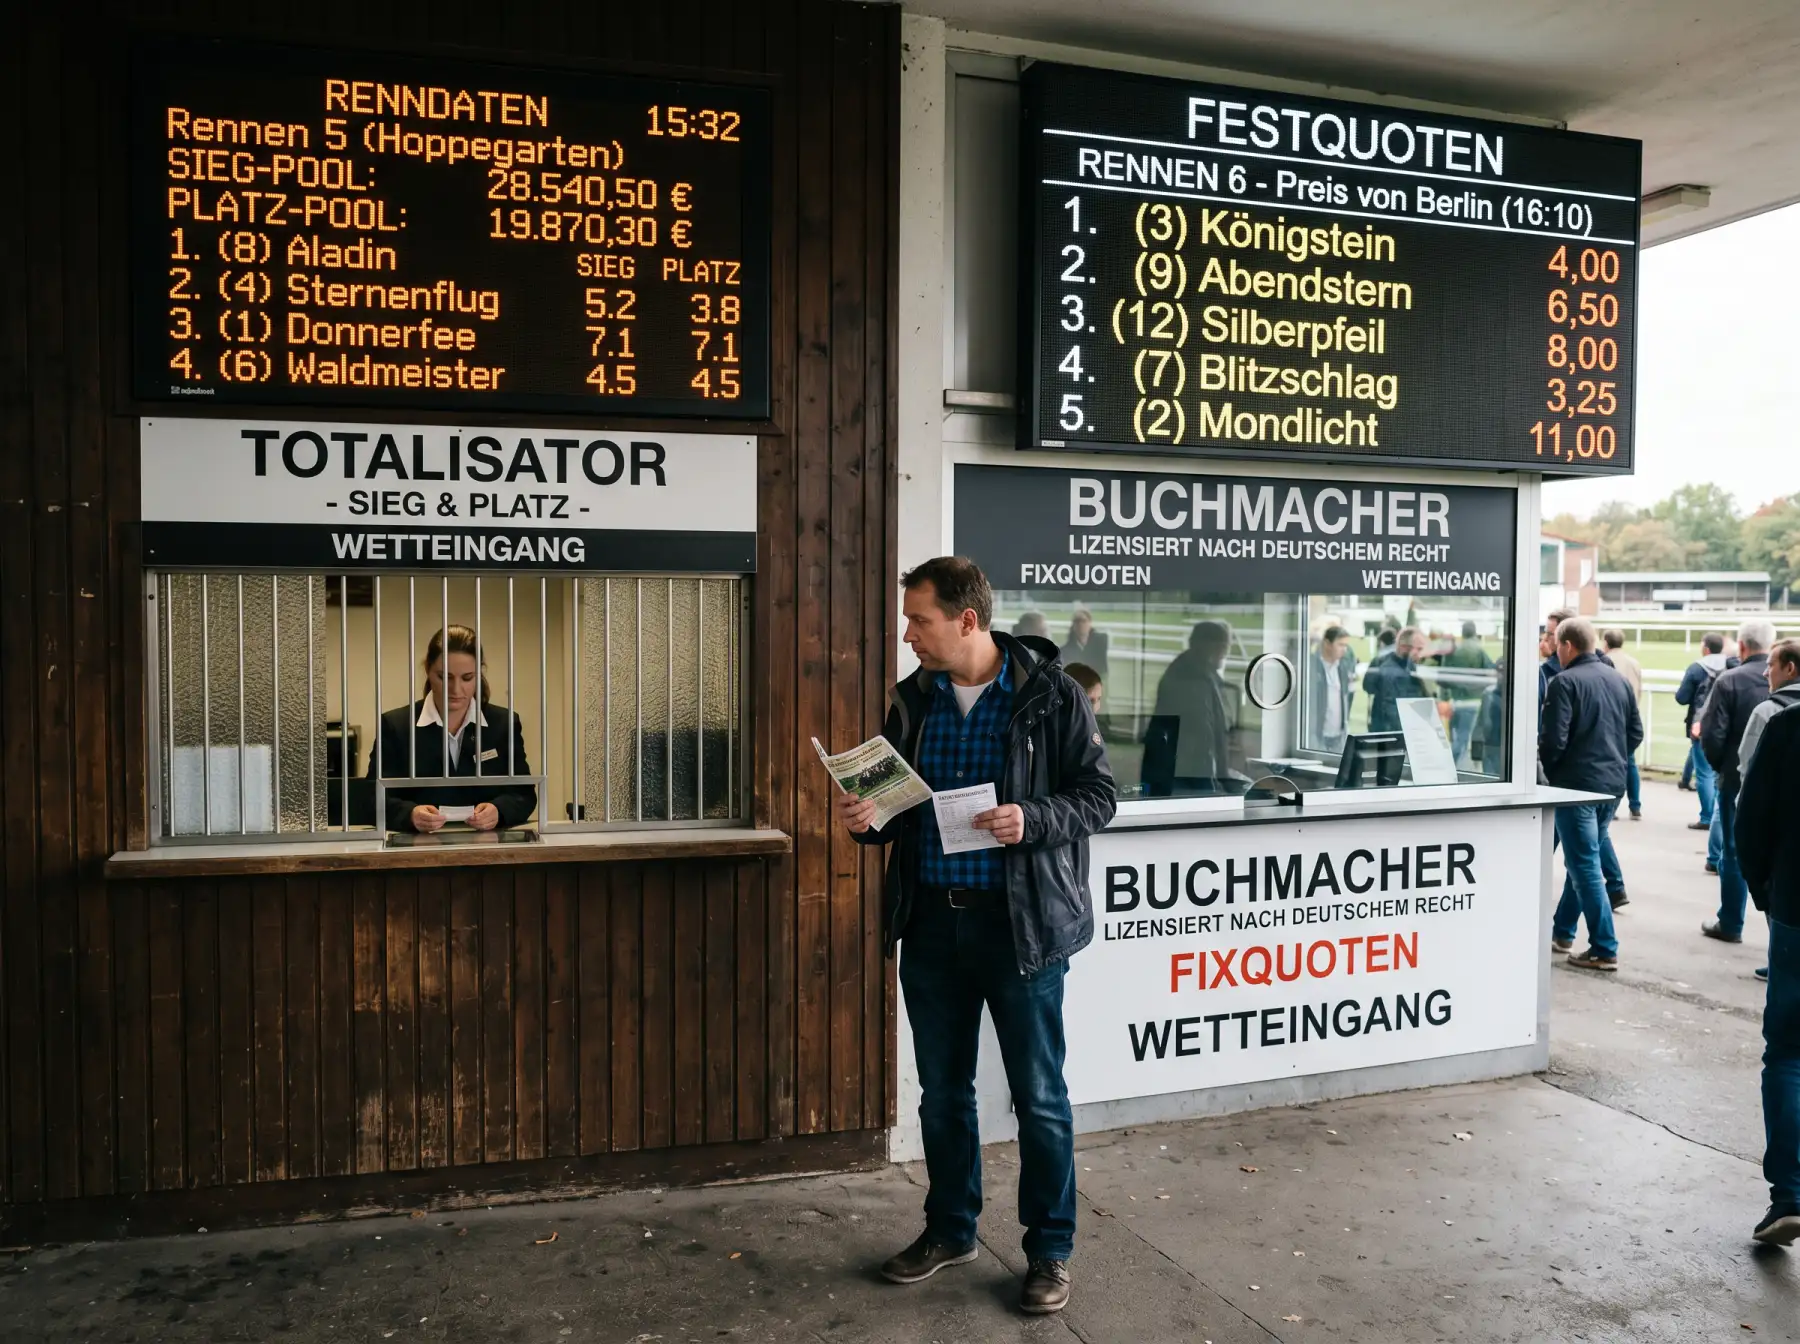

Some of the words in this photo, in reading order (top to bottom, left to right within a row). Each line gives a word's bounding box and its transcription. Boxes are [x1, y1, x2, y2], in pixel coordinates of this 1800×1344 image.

[168, 108, 308, 148] Rennen
[326, 118, 347, 150] 5
[364, 122, 623, 170] (Hoppegarten)
[326, 79, 547, 127] RENNDATEN
[648, 106, 740, 141] 15:32
[1189, 97, 1502, 175] FESTQUOTEN
[169, 148, 374, 190] SIEG-POOL:
[488, 170, 657, 210] 28.540,50
[671, 183, 692, 211] €
[1080, 148, 1218, 191] RENNEN
[1229, 165, 1246, 193] 6
[1277, 176, 1348, 204] Preis
[1357, 186, 1406, 210] von
[1417, 186, 1492, 220] Berlin
[1502, 197, 1593, 238] (16:10)
[169, 187, 406, 231] PLATZ-POOL:
[491, 208, 657, 248] 19.870,30
[671, 220, 692, 248] €
[1065, 196, 1096, 233] 1.
[1136, 203, 1187, 250] (3)
[1202, 209, 1394, 262] Königstein
[1549, 246, 1619, 285] 4,00
[172, 228, 199, 260] 1.
[219, 231, 270, 263] (8)
[288, 234, 396, 270] Aladin
[578, 254, 634, 279] SIEG
[664, 258, 740, 284] PLATZ
[170, 268, 200, 299] 2.
[219, 271, 270, 303] (4)
[288, 273, 498, 320] Sternenflug
[586, 288, 635, 320] 5.2
[691, 294, 740, 324] 3.8
[1061, 245, 1095, 283] 2.
[1135, 252, 1186, 299] (9)
[1199, 258, 1411, 310] Abendstern
[1548, 289, 1618, 329] 6,50
[170, 307, 200, 339] 3.
[220, 310, 271, 342] (1)
[288, 312, 475, 350] Donnerfee
[586, 326, 634, 358] 7.1
[691, 331, 738, 362] 7.1
[1061, 295, 1095, 332] 3.
[1113, 299, 1188, 348] (12)
[1202, 306, 1384, 357] Silberpfeil
[1548, 334, 1617, 375] 8,00
[171, 348, 201, 379] 4.
[220, 350, 271, 381] (6)
[288, 352, 505, 389] Waldmeister
[586, 364, 636, 394] 4.5
[691, 368, 739, 398] 4.5
[1059, 345, 1094, 382] 4.
[1134, 349, 1185, 396] (7)
[1201, 354, 1397, 409] Blitzschlag
[1547, 378, 1616, 418] 3,25
[241, 429, 666, 486] TOTALISATOR
[1060, 394, 1094, 431] 5.
[1134, 398, 1185, 444] (2)
[1200, 402, 1378, 446] Mondlicht
[1530, 421, 1616, 462] 11,00
[349, 490, 425, 516] SIEG
[437, 492, 459, 516] &
[470, 493, 569, 518] PLATZ
[1070, 478, 1449, 537] BUCHMACHER
[332, 534, 584, 562] WETTEINGANG
[1021, 564, 1150, 585] FIXQUOTEN
[1070, 535, 1192, 556] LIZENSIERT
[1199, 538, 1255, 558] NACH
[1263, 540, 1382, 560] DEUTSCHEM
[1389, 543, 1450, 562] RECHT
[1362, 570, 1500, 591] WETTEINGANG
[1106, 843, 1476, 913] BUCHMACHER
[1105, 914, 1224, 940] LIZENSIERT
[1231, 909, 1284, 930] NACH
[1293, 899, 1408, 924] DEUTSCHEM
[1416, 894, 1474, 914] RECHT
[1171, 932, 1417, 992] FIXQUOTEN
[1128, 990, 1451, 1062] WETTEINGANG
